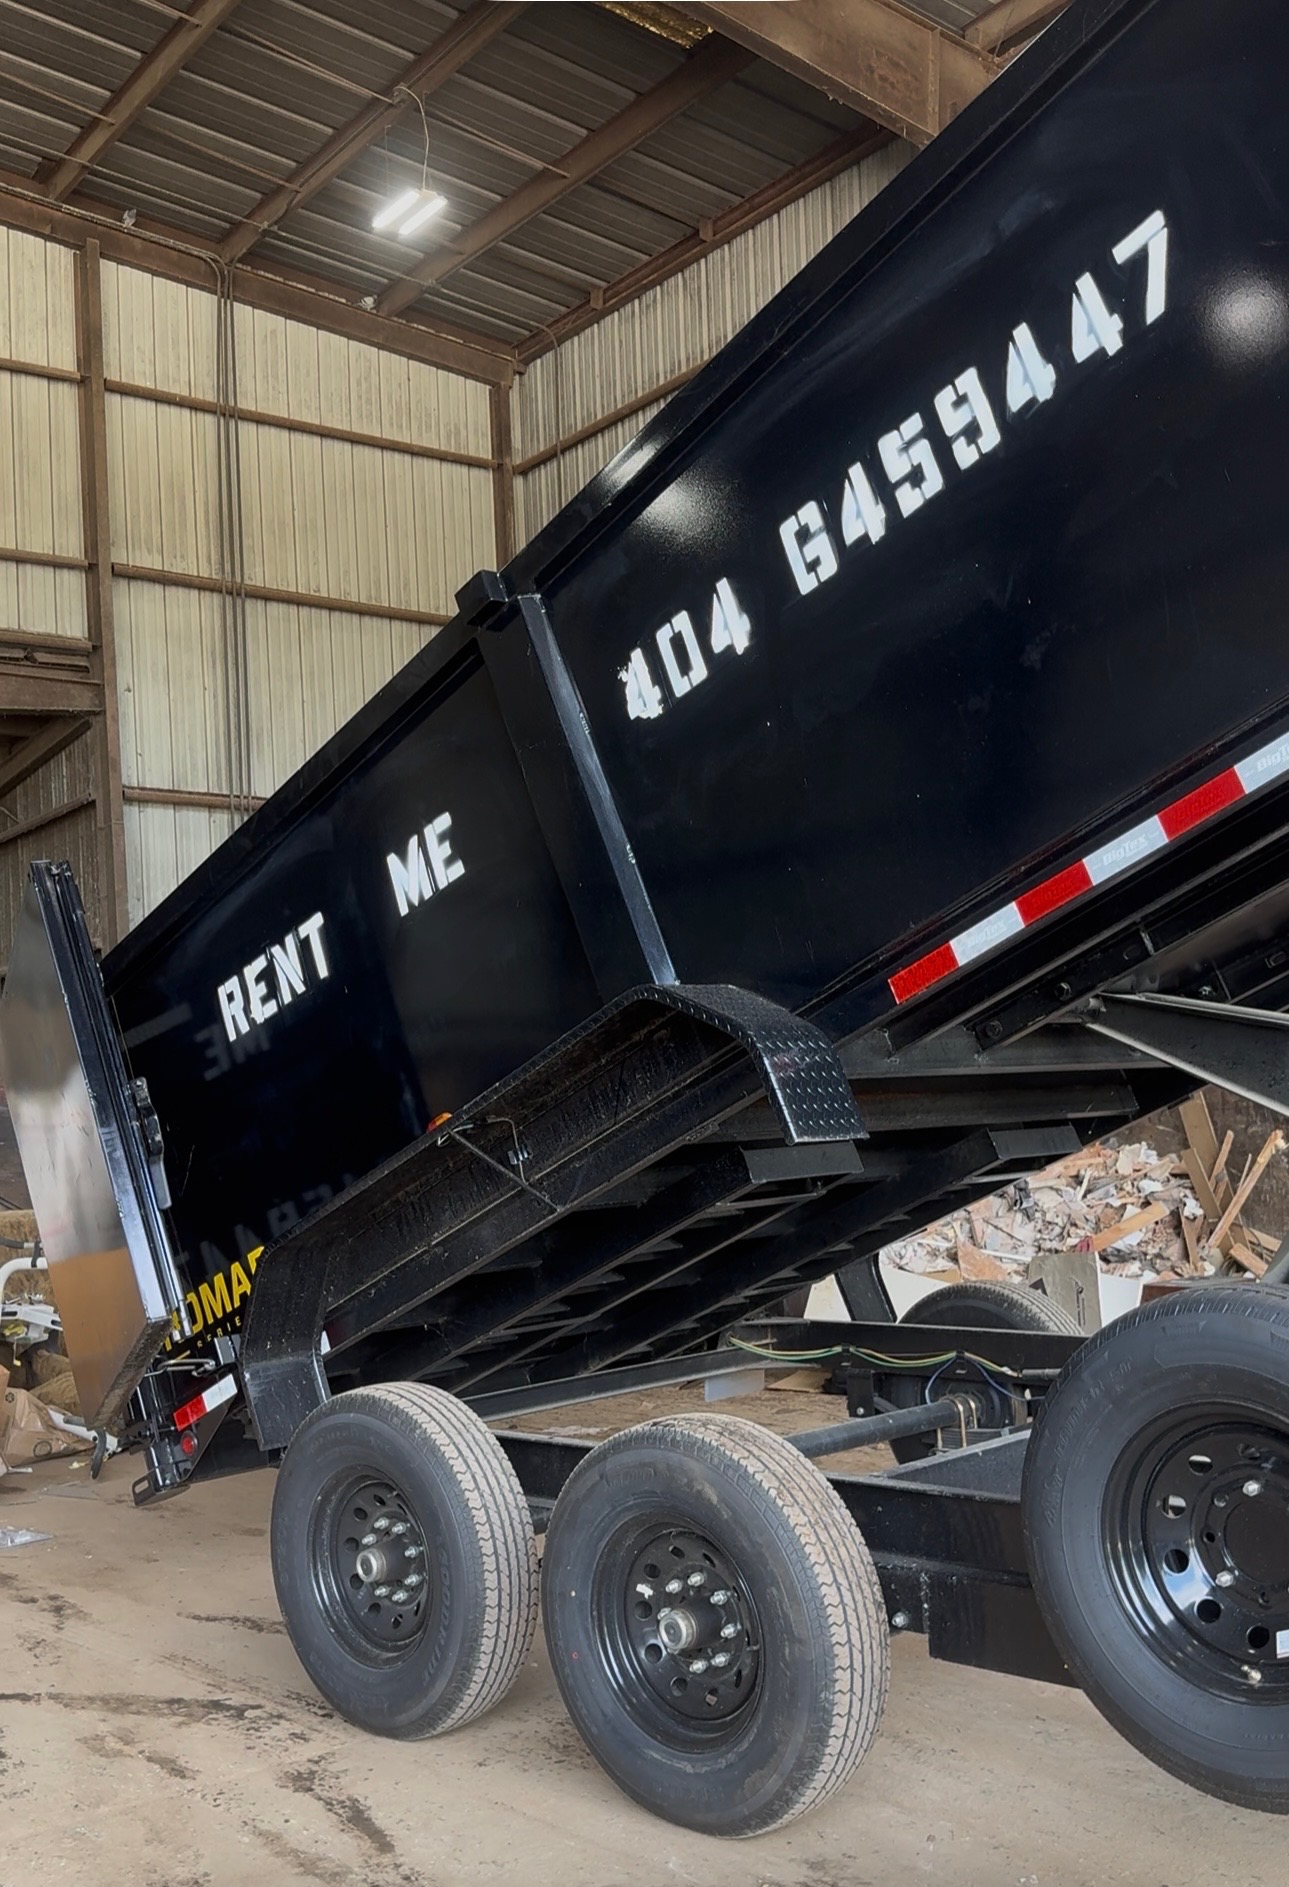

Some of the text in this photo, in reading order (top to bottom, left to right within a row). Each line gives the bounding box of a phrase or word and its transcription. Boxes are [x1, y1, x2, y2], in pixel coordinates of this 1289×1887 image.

[620, 577, 752, 720] 404
[217, 811, 466, 1042] RENT ME
